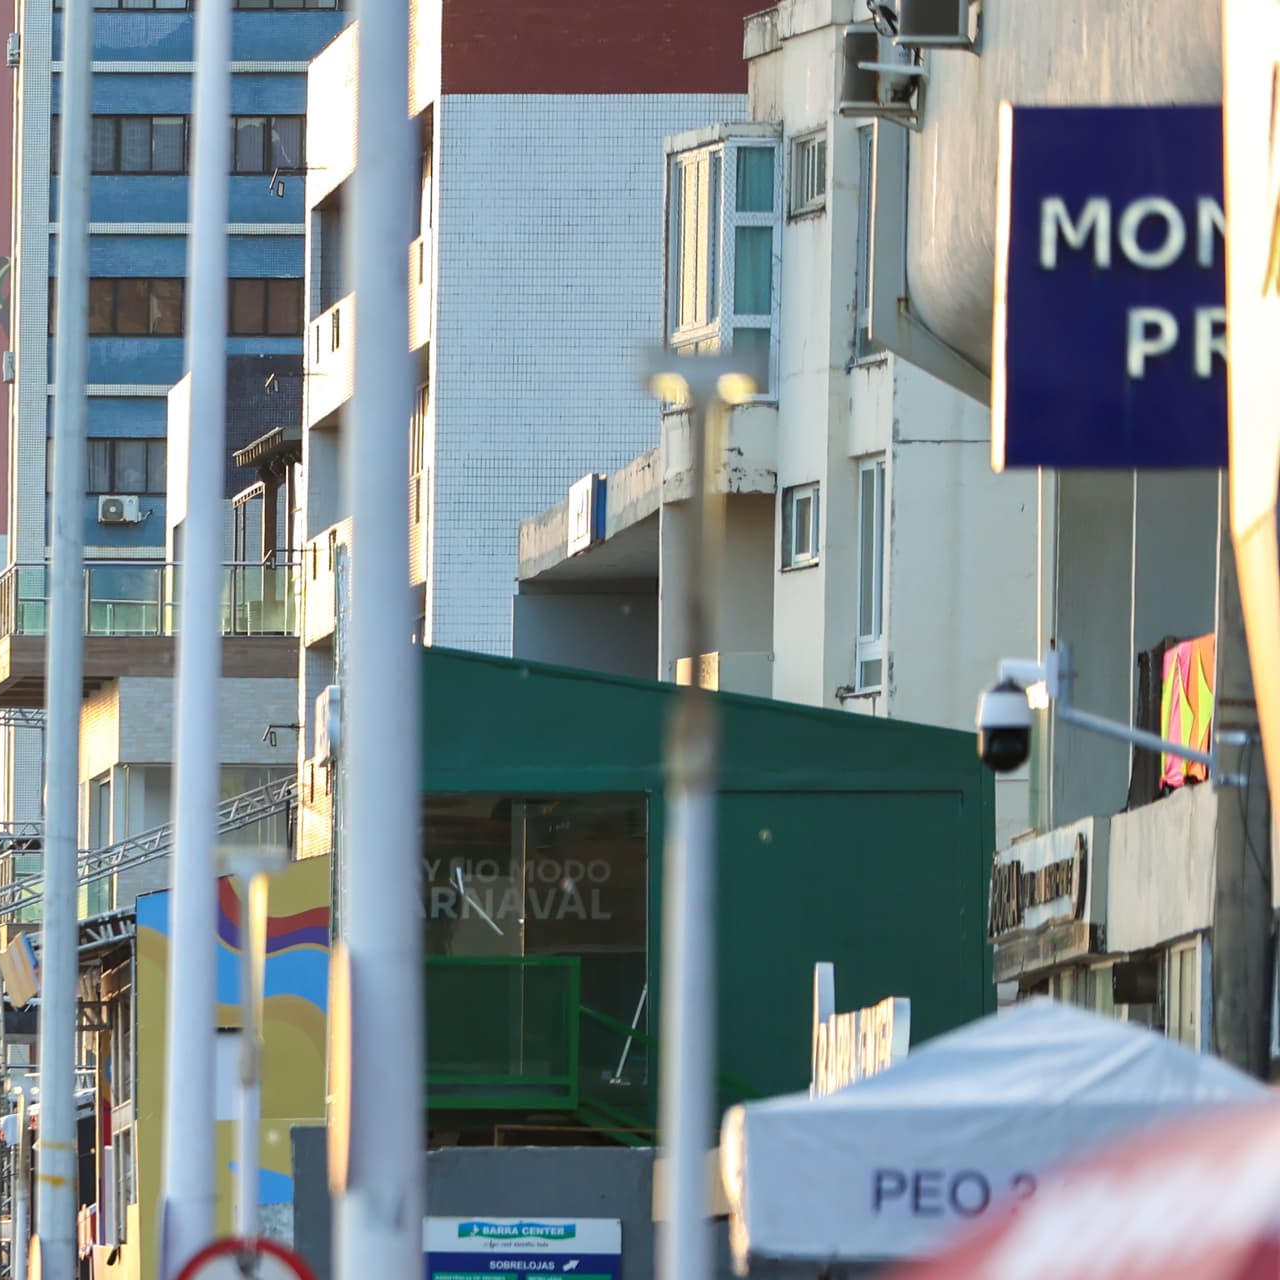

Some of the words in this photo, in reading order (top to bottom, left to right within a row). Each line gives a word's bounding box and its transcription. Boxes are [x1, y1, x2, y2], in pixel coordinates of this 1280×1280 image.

[508, 859, 612, 884] MODO
[417, 886, 613, 920] RNAVAL
[872, 1167, 991, 1219] PEO
[482, 1226, 520, 1236] BARRA
[521, 1226, 566, 1236] CENTER
[489, 1260, 555, 1271] SOBRELOJAS
